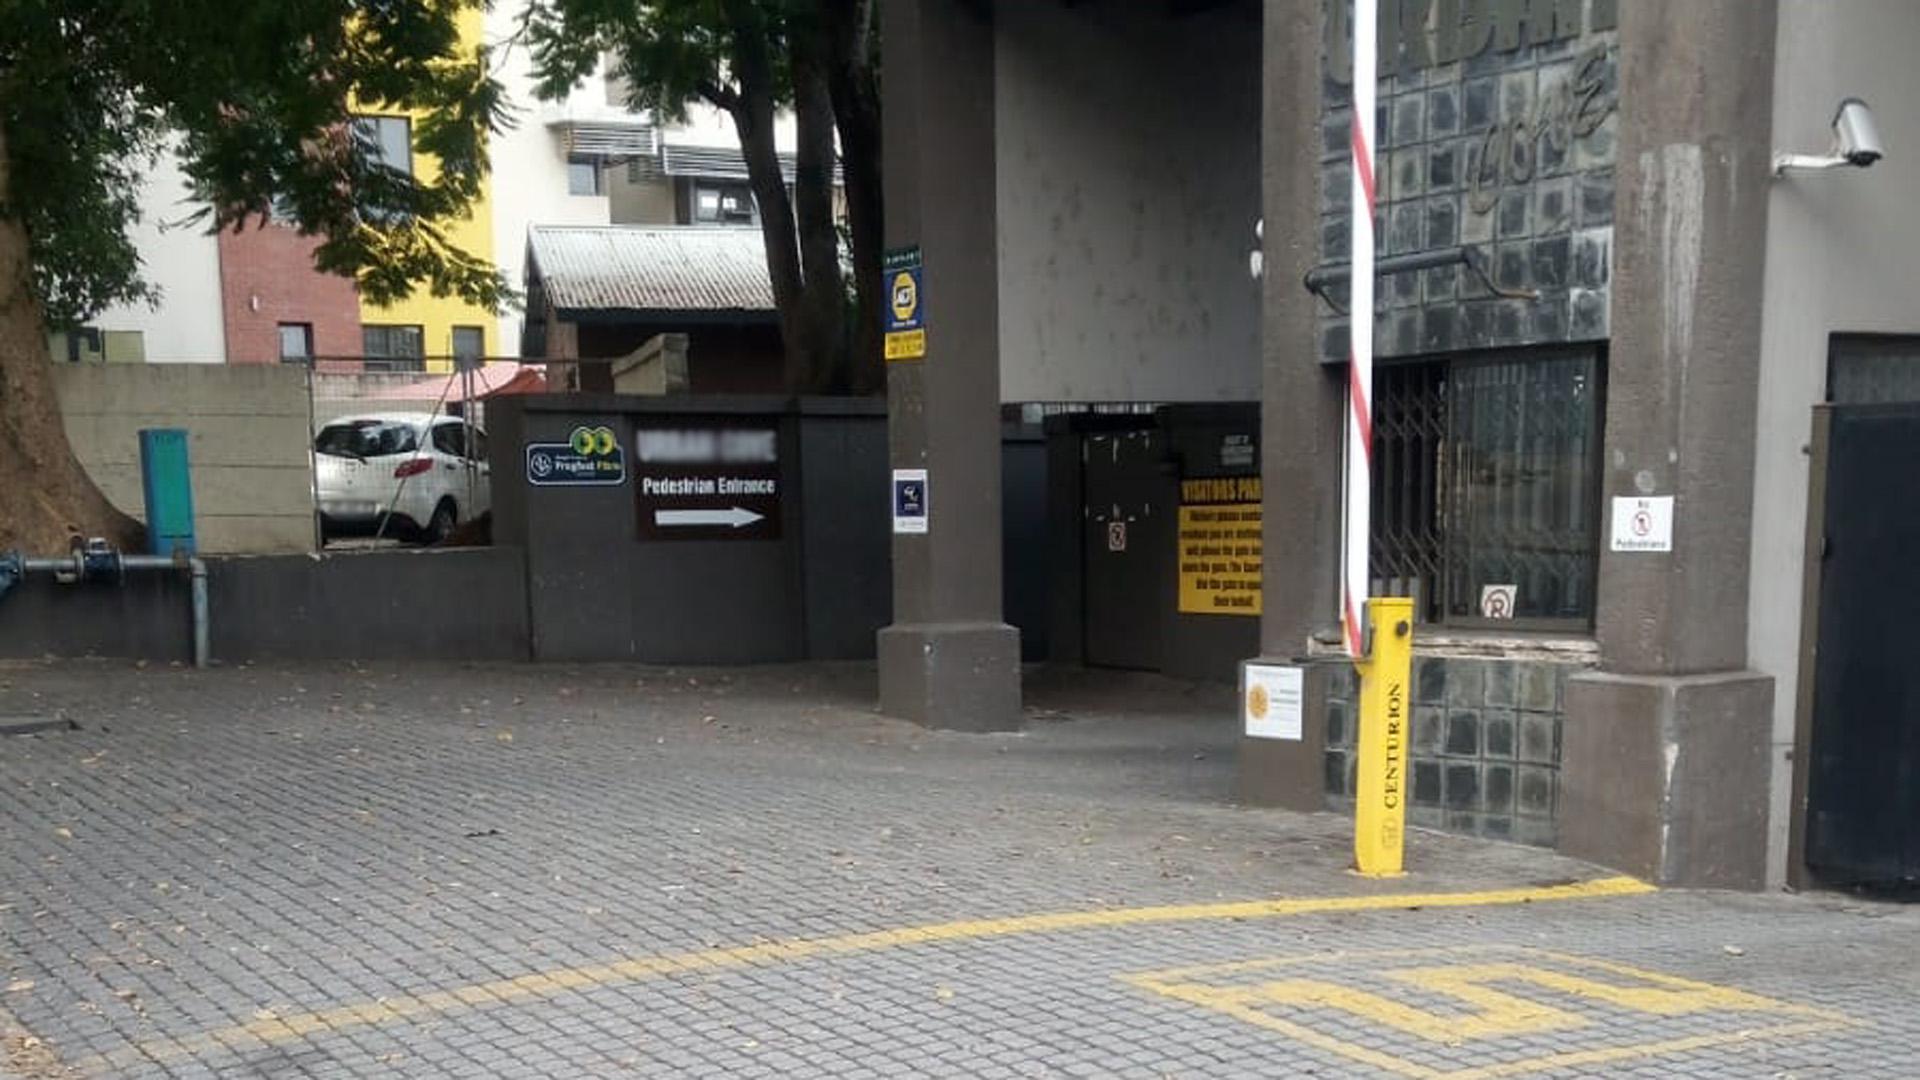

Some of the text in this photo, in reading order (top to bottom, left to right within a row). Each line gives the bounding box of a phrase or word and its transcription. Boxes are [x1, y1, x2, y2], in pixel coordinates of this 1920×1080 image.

[643, 477, 775, 495] Pedestrian Entrance
[1383, 683, 1401, 810] CENTURION
